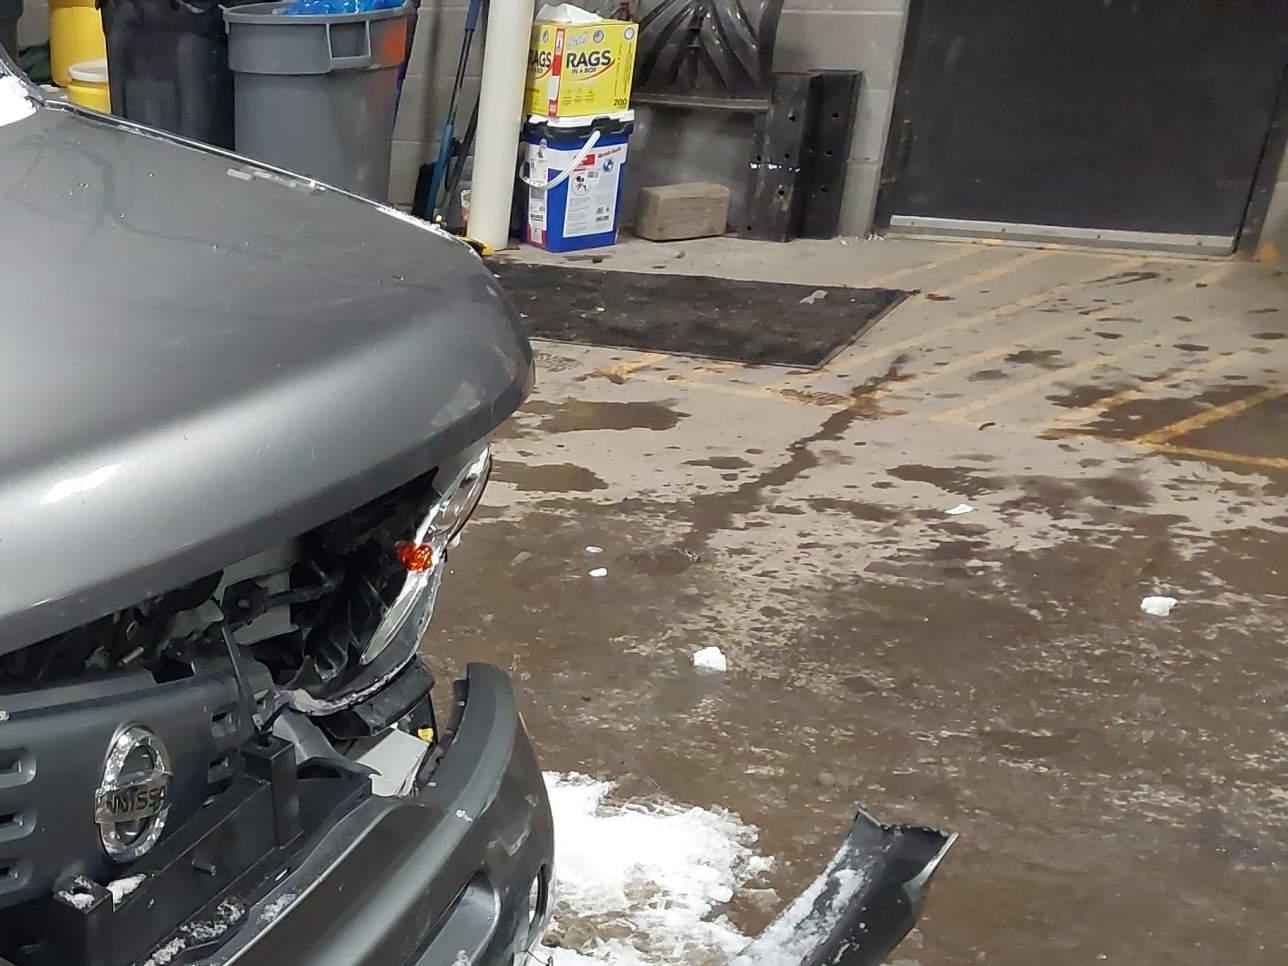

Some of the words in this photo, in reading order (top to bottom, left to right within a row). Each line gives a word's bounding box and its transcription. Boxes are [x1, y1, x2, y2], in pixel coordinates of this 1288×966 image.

[566, 50, 611, 68] RAGS
[613, 98, 627, 106] 200
[106, 784, 168, 814] NISSA
